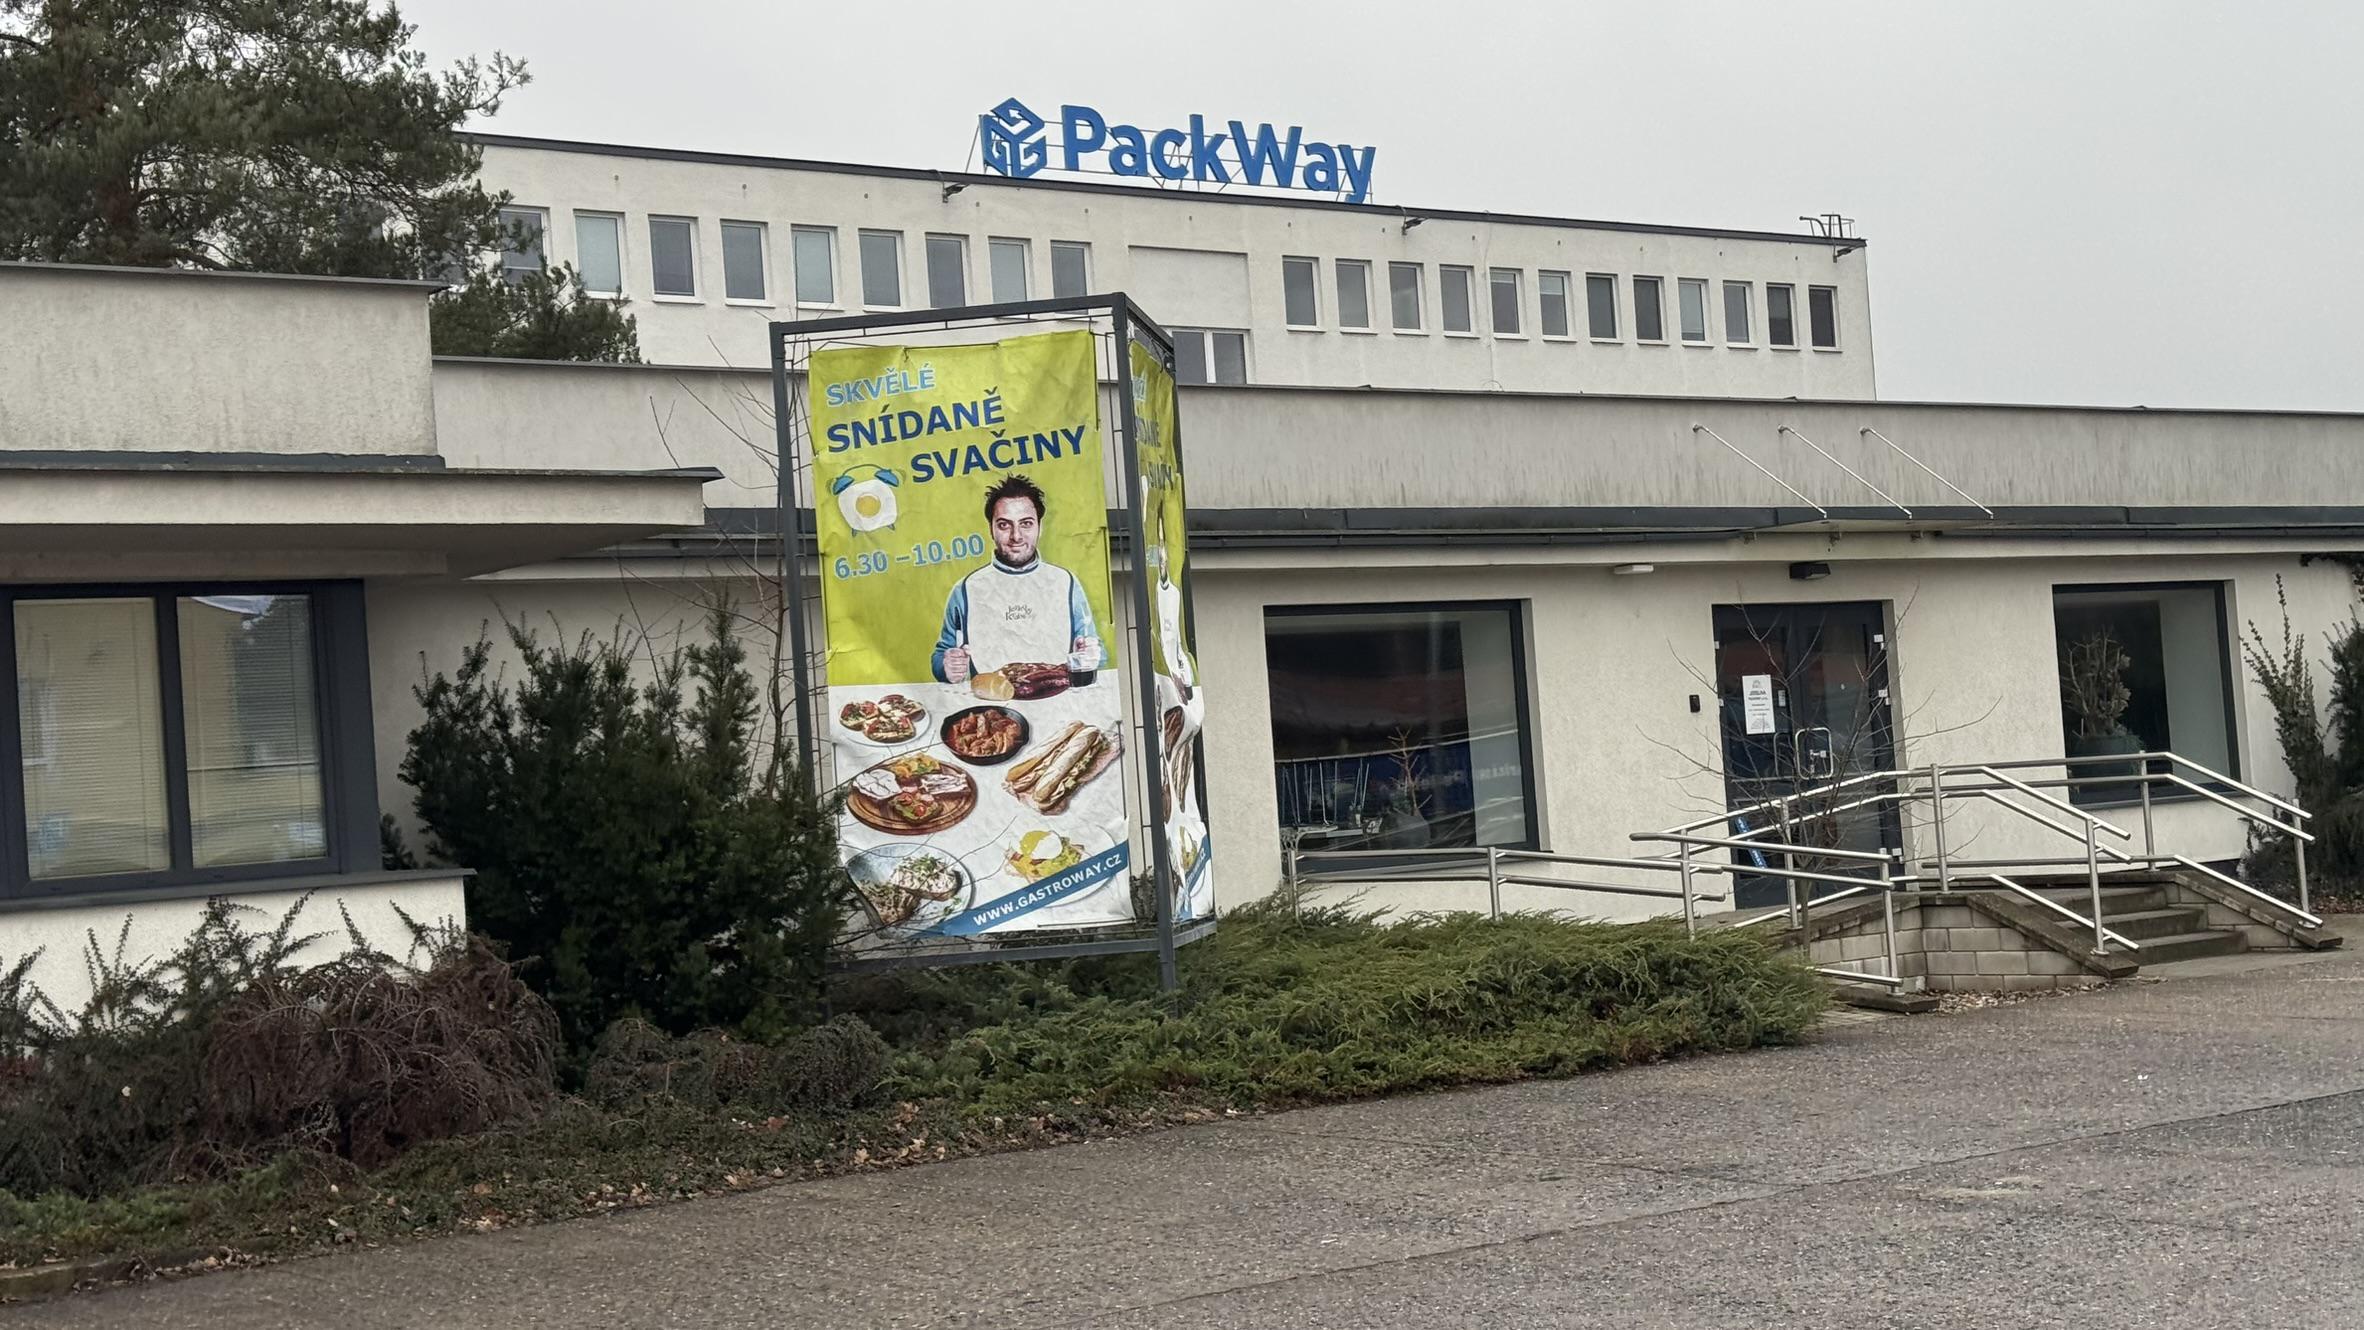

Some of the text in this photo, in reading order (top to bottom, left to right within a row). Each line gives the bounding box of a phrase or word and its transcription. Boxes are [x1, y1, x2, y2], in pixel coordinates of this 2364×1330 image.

[1061, 104, 1377, 204] PackWay
[826, 362, 936, 407] SKVĚLÉ
[826, 386, 1005, 453] SNÍDANĚ
[910, 424, 1086, 483] SVAČINY
[972, 853, 1122, 926] WWW.GASTROWAY.CZ
